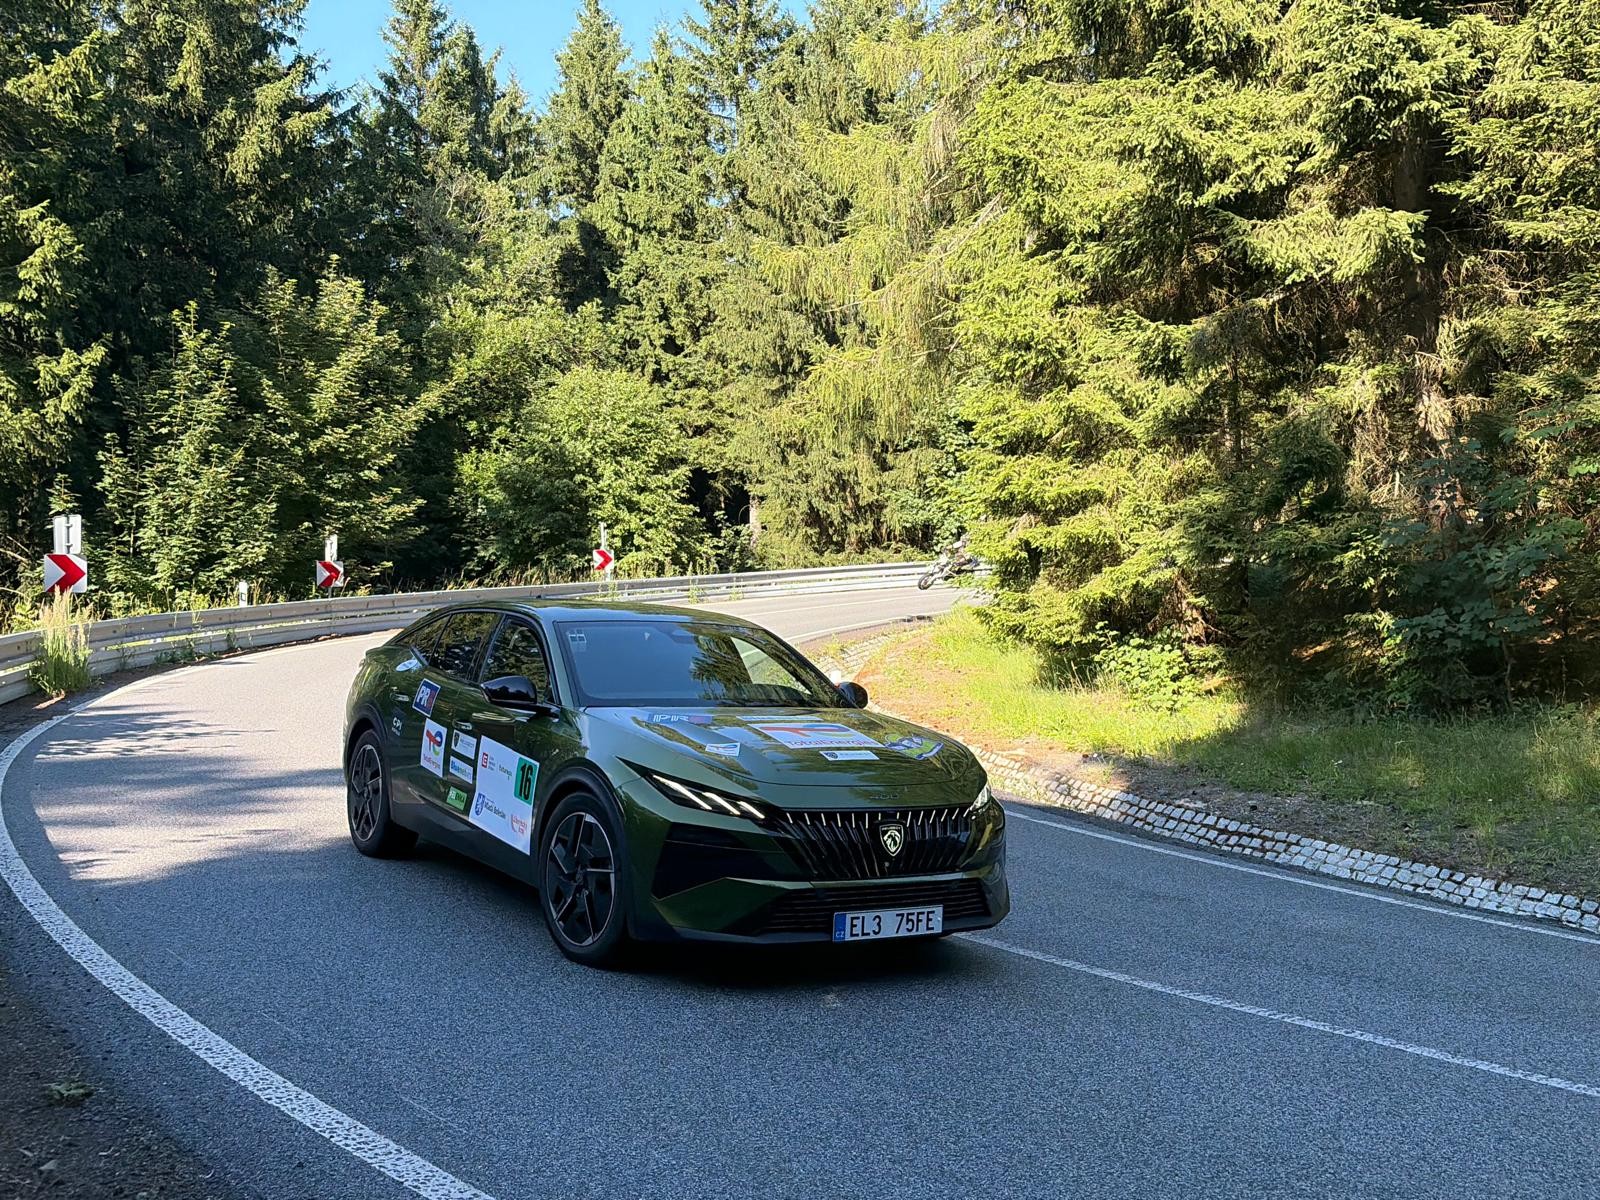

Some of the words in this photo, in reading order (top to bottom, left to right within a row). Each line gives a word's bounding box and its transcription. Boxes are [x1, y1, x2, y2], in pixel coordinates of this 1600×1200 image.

[520, 762, 534, 800] 16
[849, 914, 882, 937] EL3
[895, 910, 936, 934] 75FE
